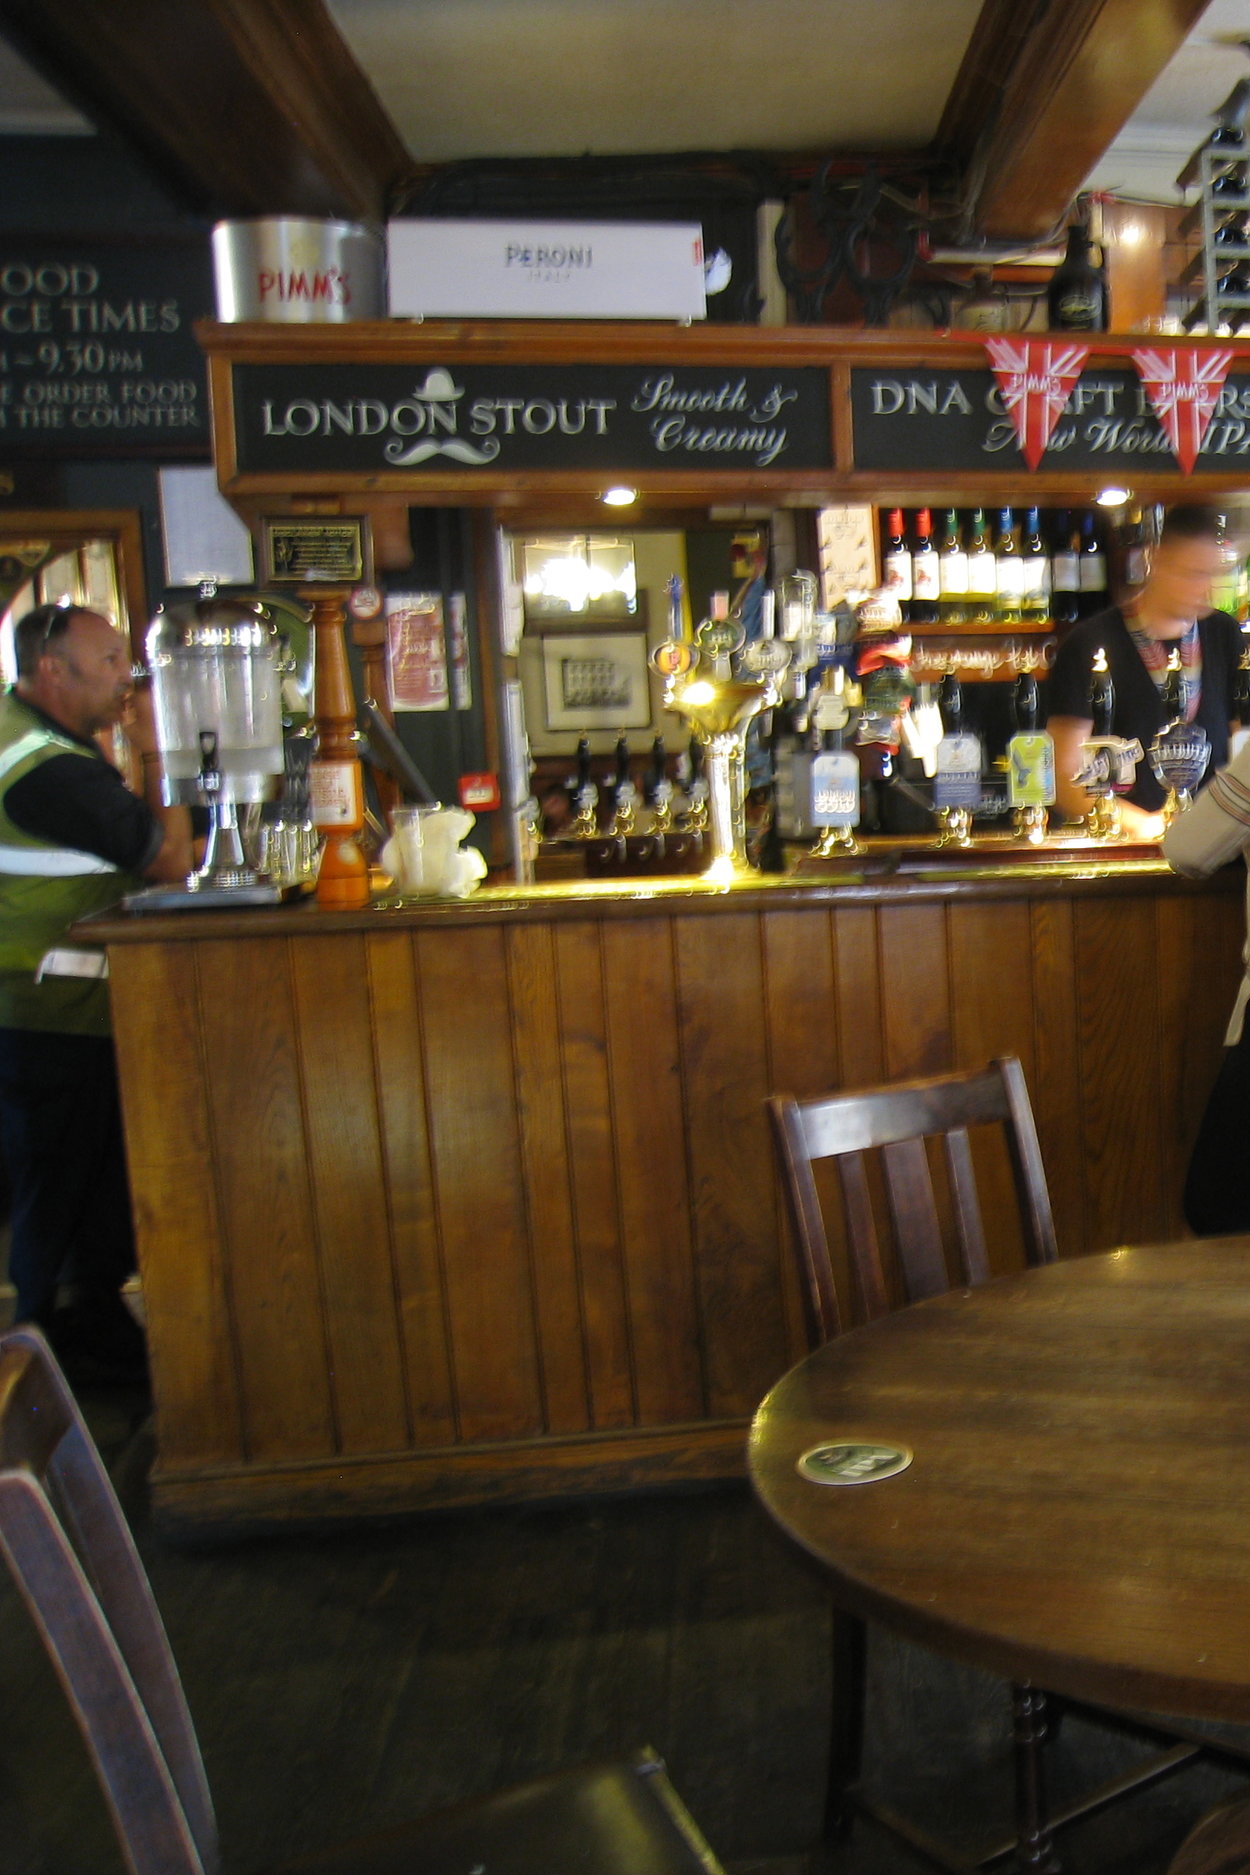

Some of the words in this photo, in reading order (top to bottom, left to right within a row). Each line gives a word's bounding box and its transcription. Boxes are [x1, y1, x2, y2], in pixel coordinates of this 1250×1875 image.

[503, 242, 593, 269] PERONI
[257, 264, 352, 305] PIMM'S
[61, 299, 181, 334] TIMES
[23, 378, 111, 405] ORDER
[121, 378, 198, 405] FOOD
[630, 372, 749, 412] Smooth
[870, 379, 973, 416] DNA
[15, 403, 65, 429] THE
[71, 402, 201, 429] COUNTER
[262, 398, 458, 436] LONDON
[469, 396, 617, 436] STOUT
[651, 414, 788, 467] Creamy
